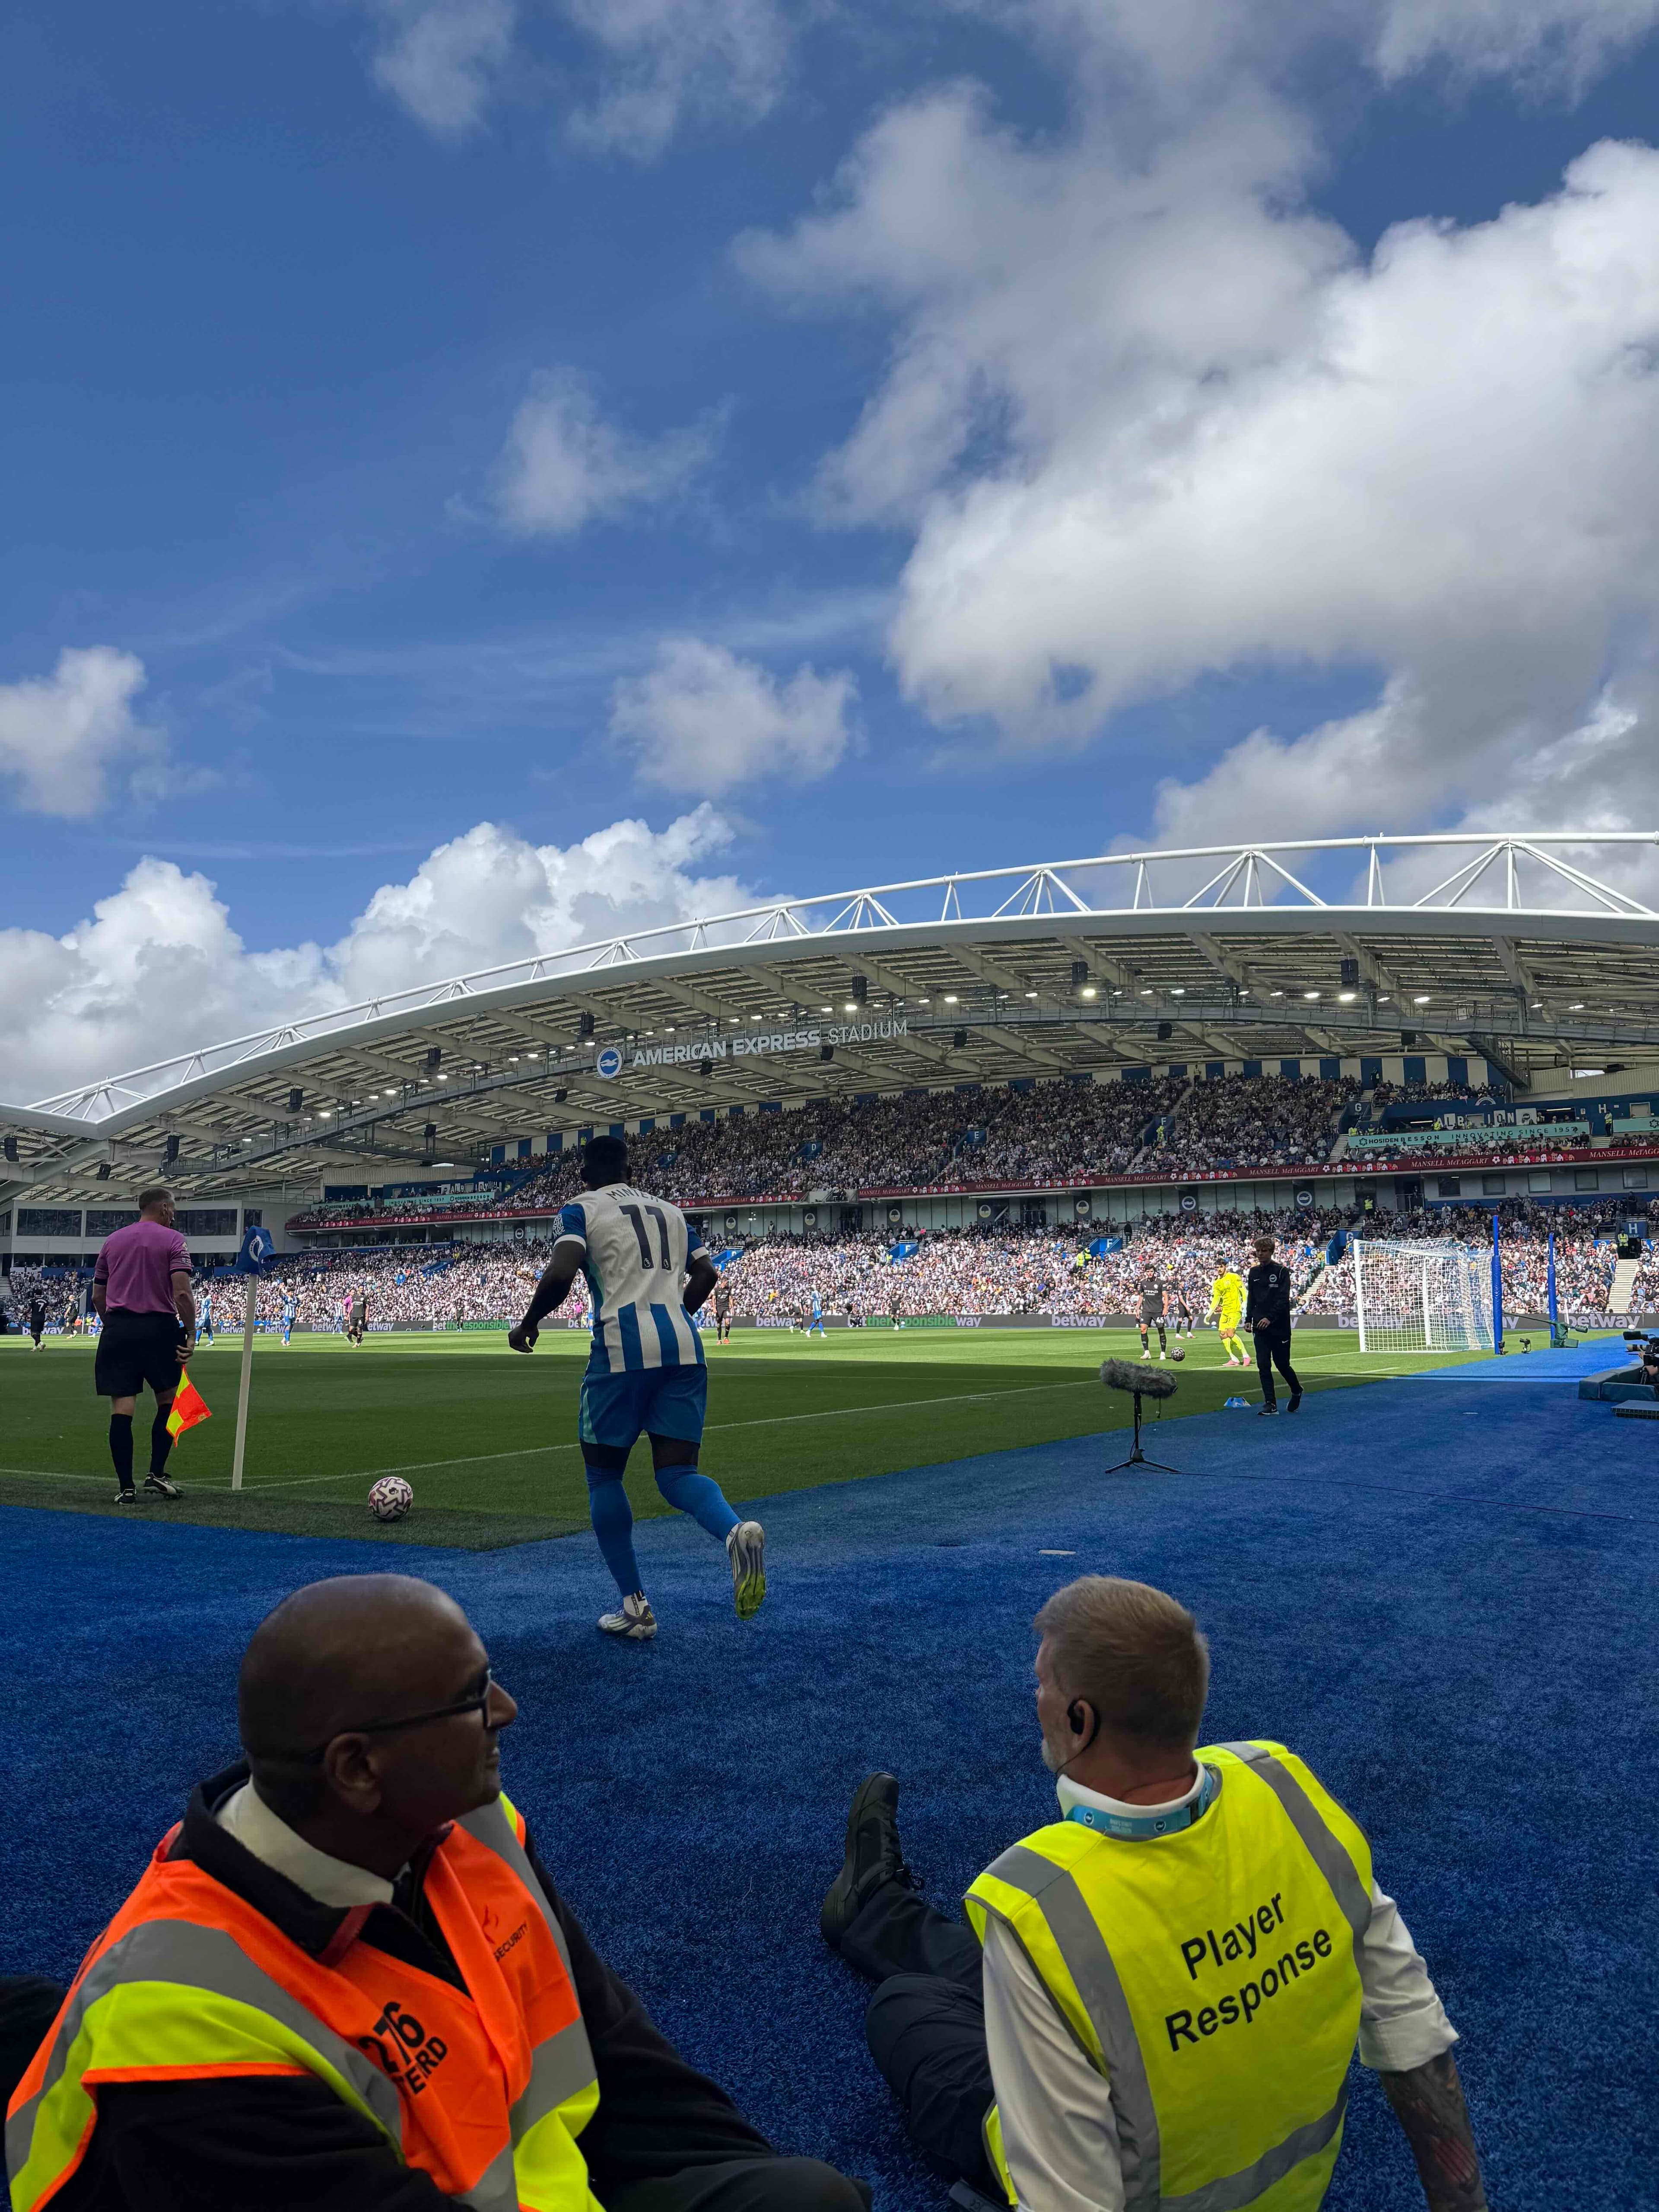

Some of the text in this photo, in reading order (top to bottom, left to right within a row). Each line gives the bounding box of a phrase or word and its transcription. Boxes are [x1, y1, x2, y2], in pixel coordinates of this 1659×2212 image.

[632, 1019, 907, 1067] AMERICAN EXPRESS STADIUM
[1355, 1103, 1361, 1112] G
[1599, 1104, 1606, 1113] H
[1452, 1130, 1514, 1139] INNOVATING
[1589, 1149, 1626, 1158] MANSELL
[1447, 1157, 1489, 1166] McTAGGART
[1628, 1223, 1638, 1233] H
[619, 1204, 672, 1271] 11
[1346, 1232, 1354, 1242] G
[1107, 1239, 1113, 1248] F
[38, 1302, 44, 1312] 7
[1052, 1314, 1106, 1328] betway
[1569, 1313, 1640, 1328] betway
[1181, 1892, 1284, 1980] Player
[1165, 1929, 1332, 2052] Response
